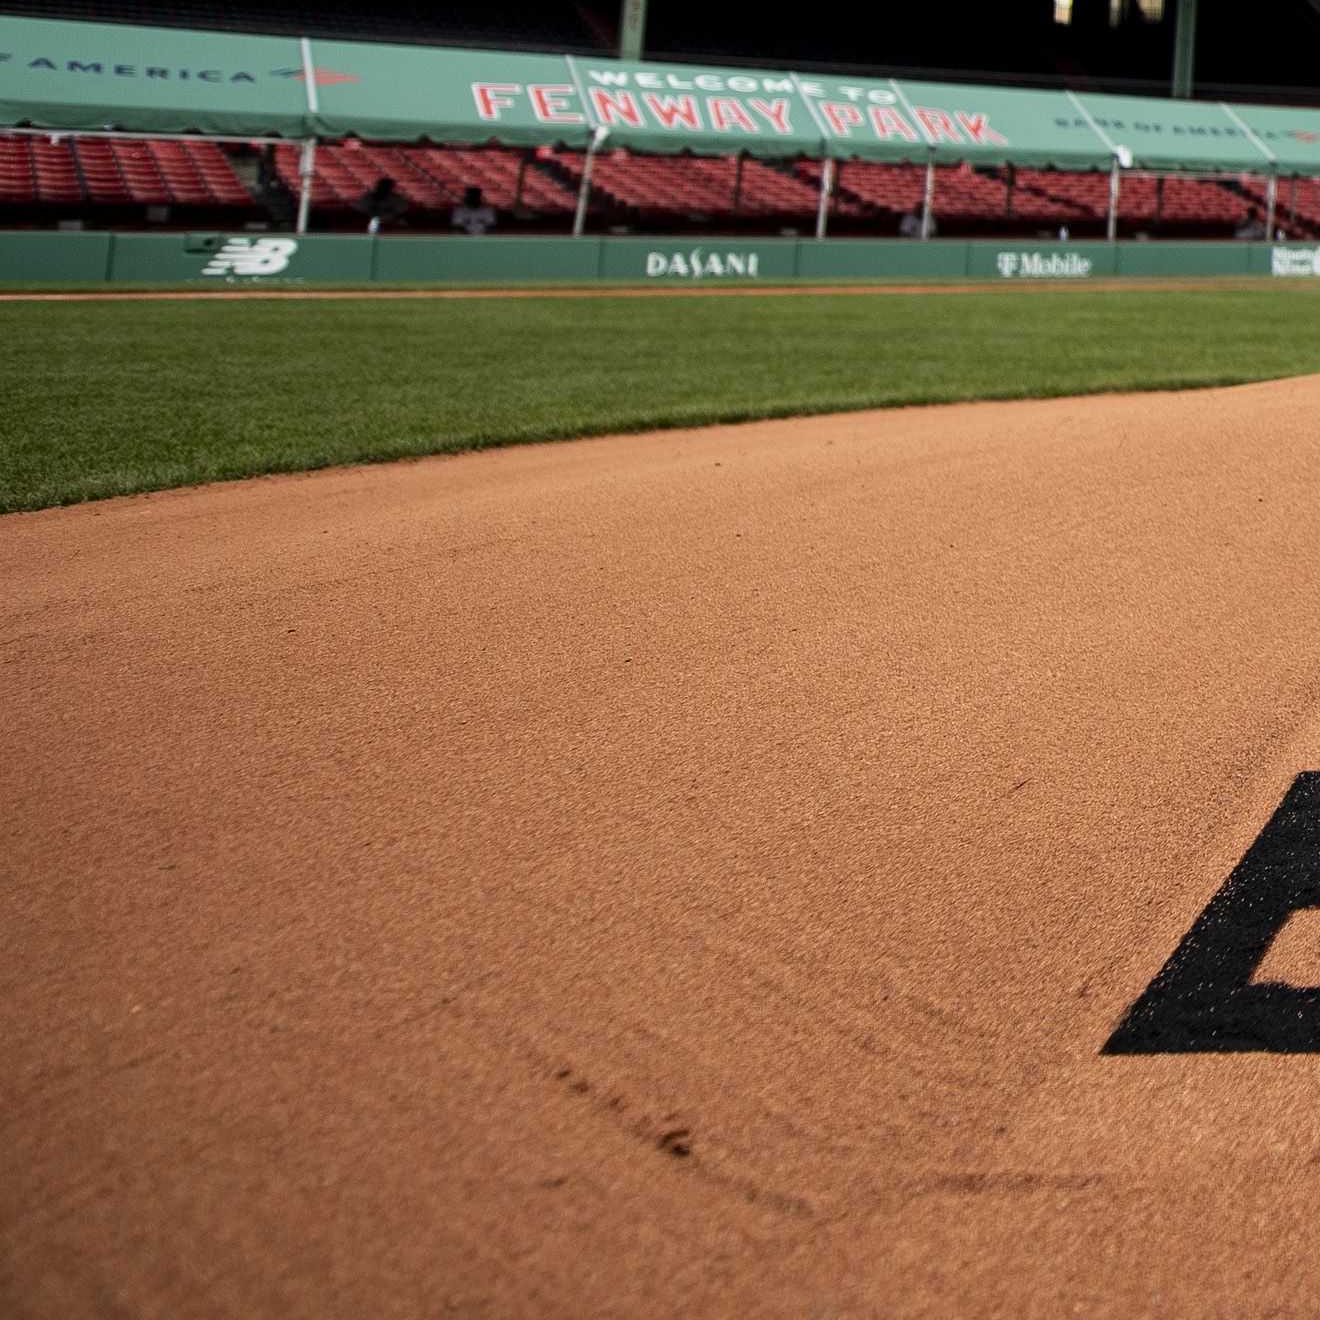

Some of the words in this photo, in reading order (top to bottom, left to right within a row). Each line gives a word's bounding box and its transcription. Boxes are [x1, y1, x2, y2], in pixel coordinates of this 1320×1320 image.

[28, 56, 256, 84] AMERICA
[587, 70, 825, 98] WELCOME
[839, 84, 897, 105] TO
[471, 82, 794, 135] FENWAY
[818, 99, 1008, 146] PARK
[645, 246, 760, 280] DASANI
[1019, 251, 1093, 279] Mobile
